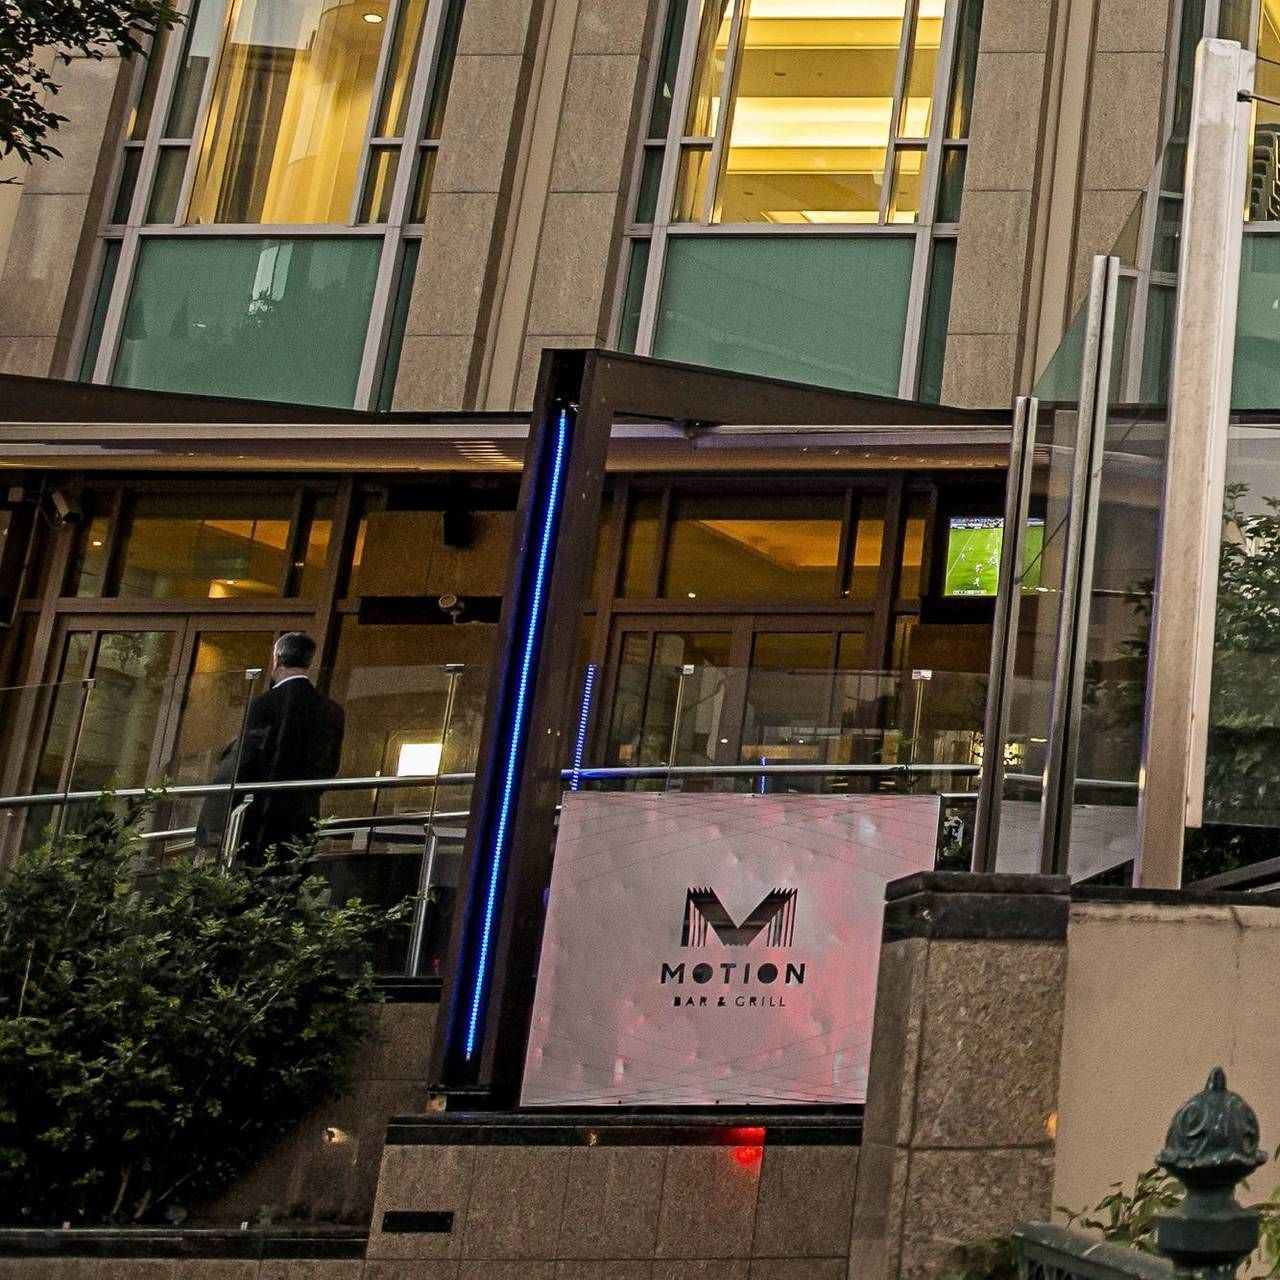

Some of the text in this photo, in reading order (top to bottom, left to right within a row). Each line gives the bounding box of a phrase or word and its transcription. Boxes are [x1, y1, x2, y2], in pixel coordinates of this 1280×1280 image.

[660, 962, 807, 986] MOTION
[673, 996, 787, 1007] BAR & GRILL
